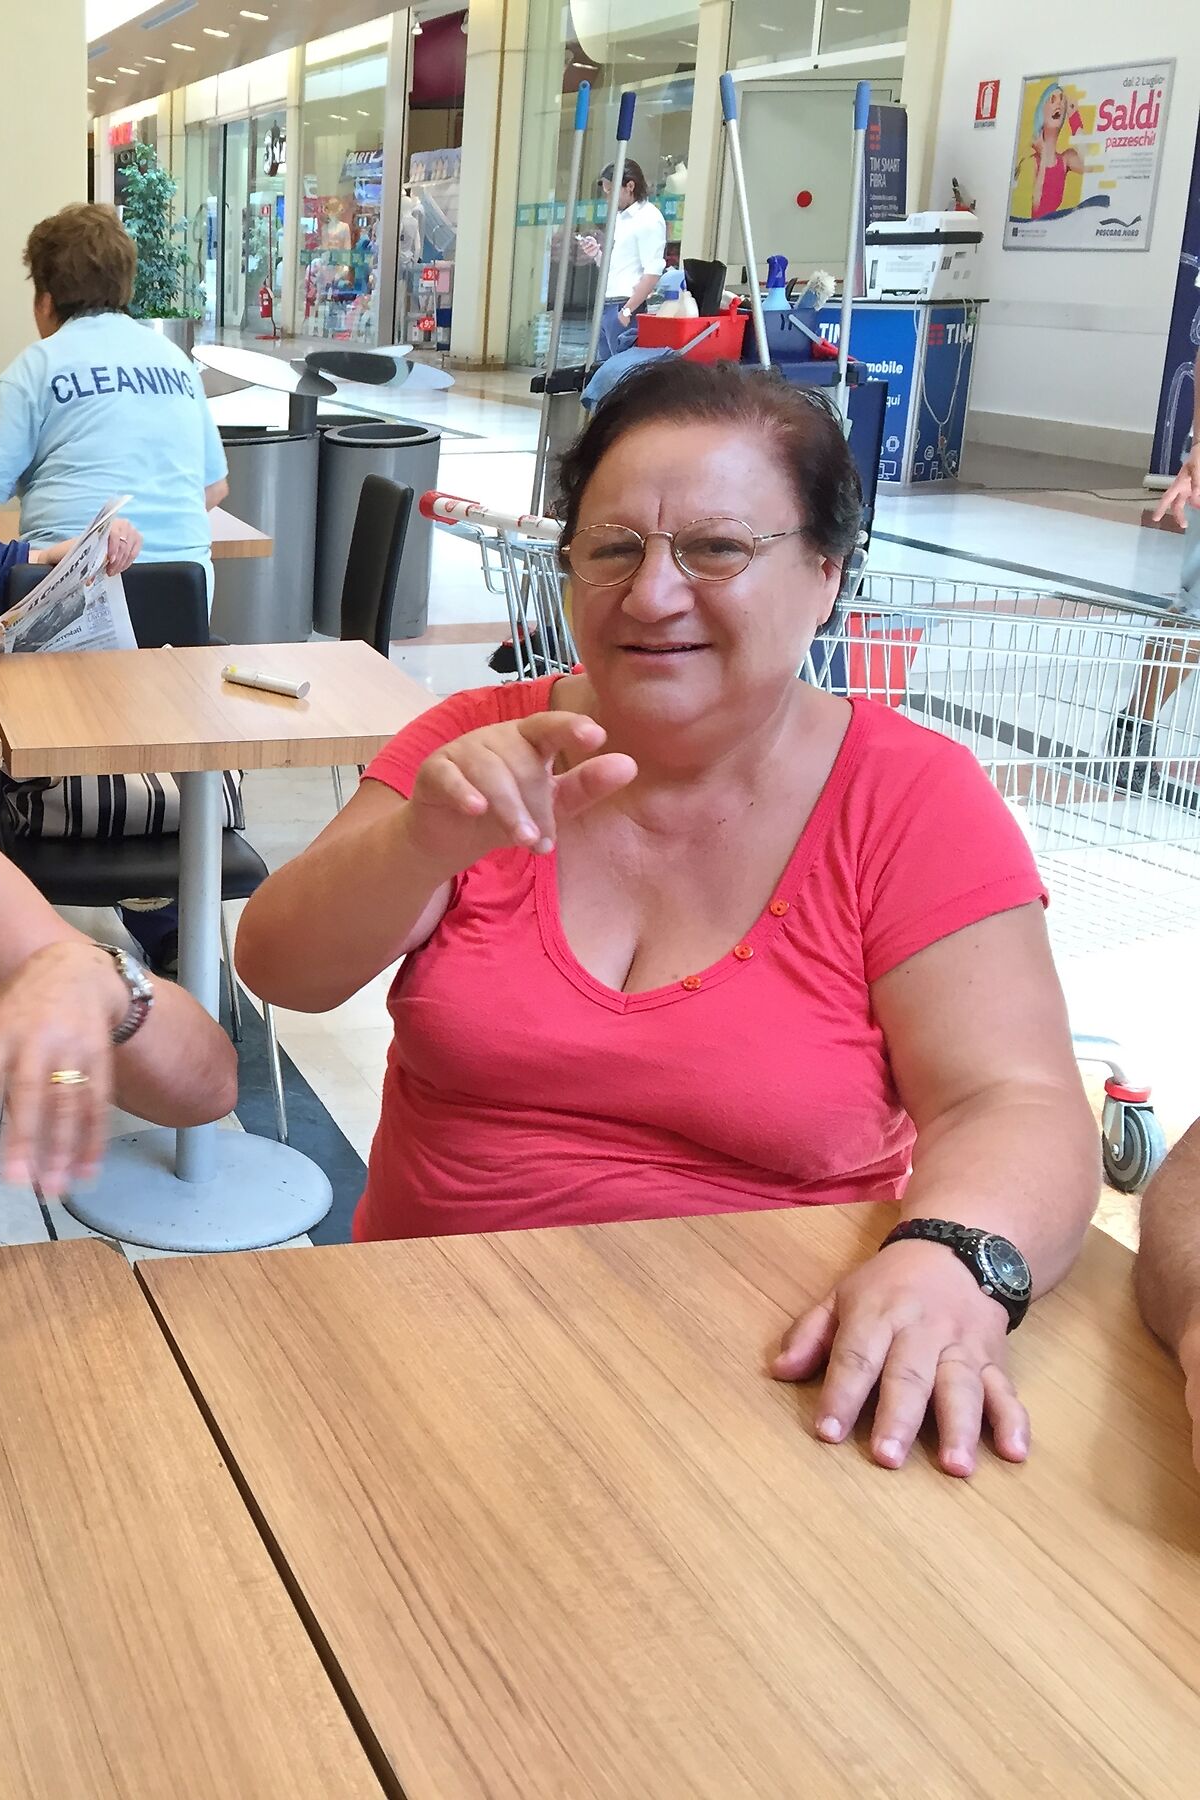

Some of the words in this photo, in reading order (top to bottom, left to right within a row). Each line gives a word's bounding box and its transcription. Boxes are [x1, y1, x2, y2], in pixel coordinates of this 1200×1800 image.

[1096, 89, 1162, 131] Saldi
[946, 323, 973, 345] TIM
[866, 360, 904, 375] mobile
[51, 366, 195, 404] CLEANING
